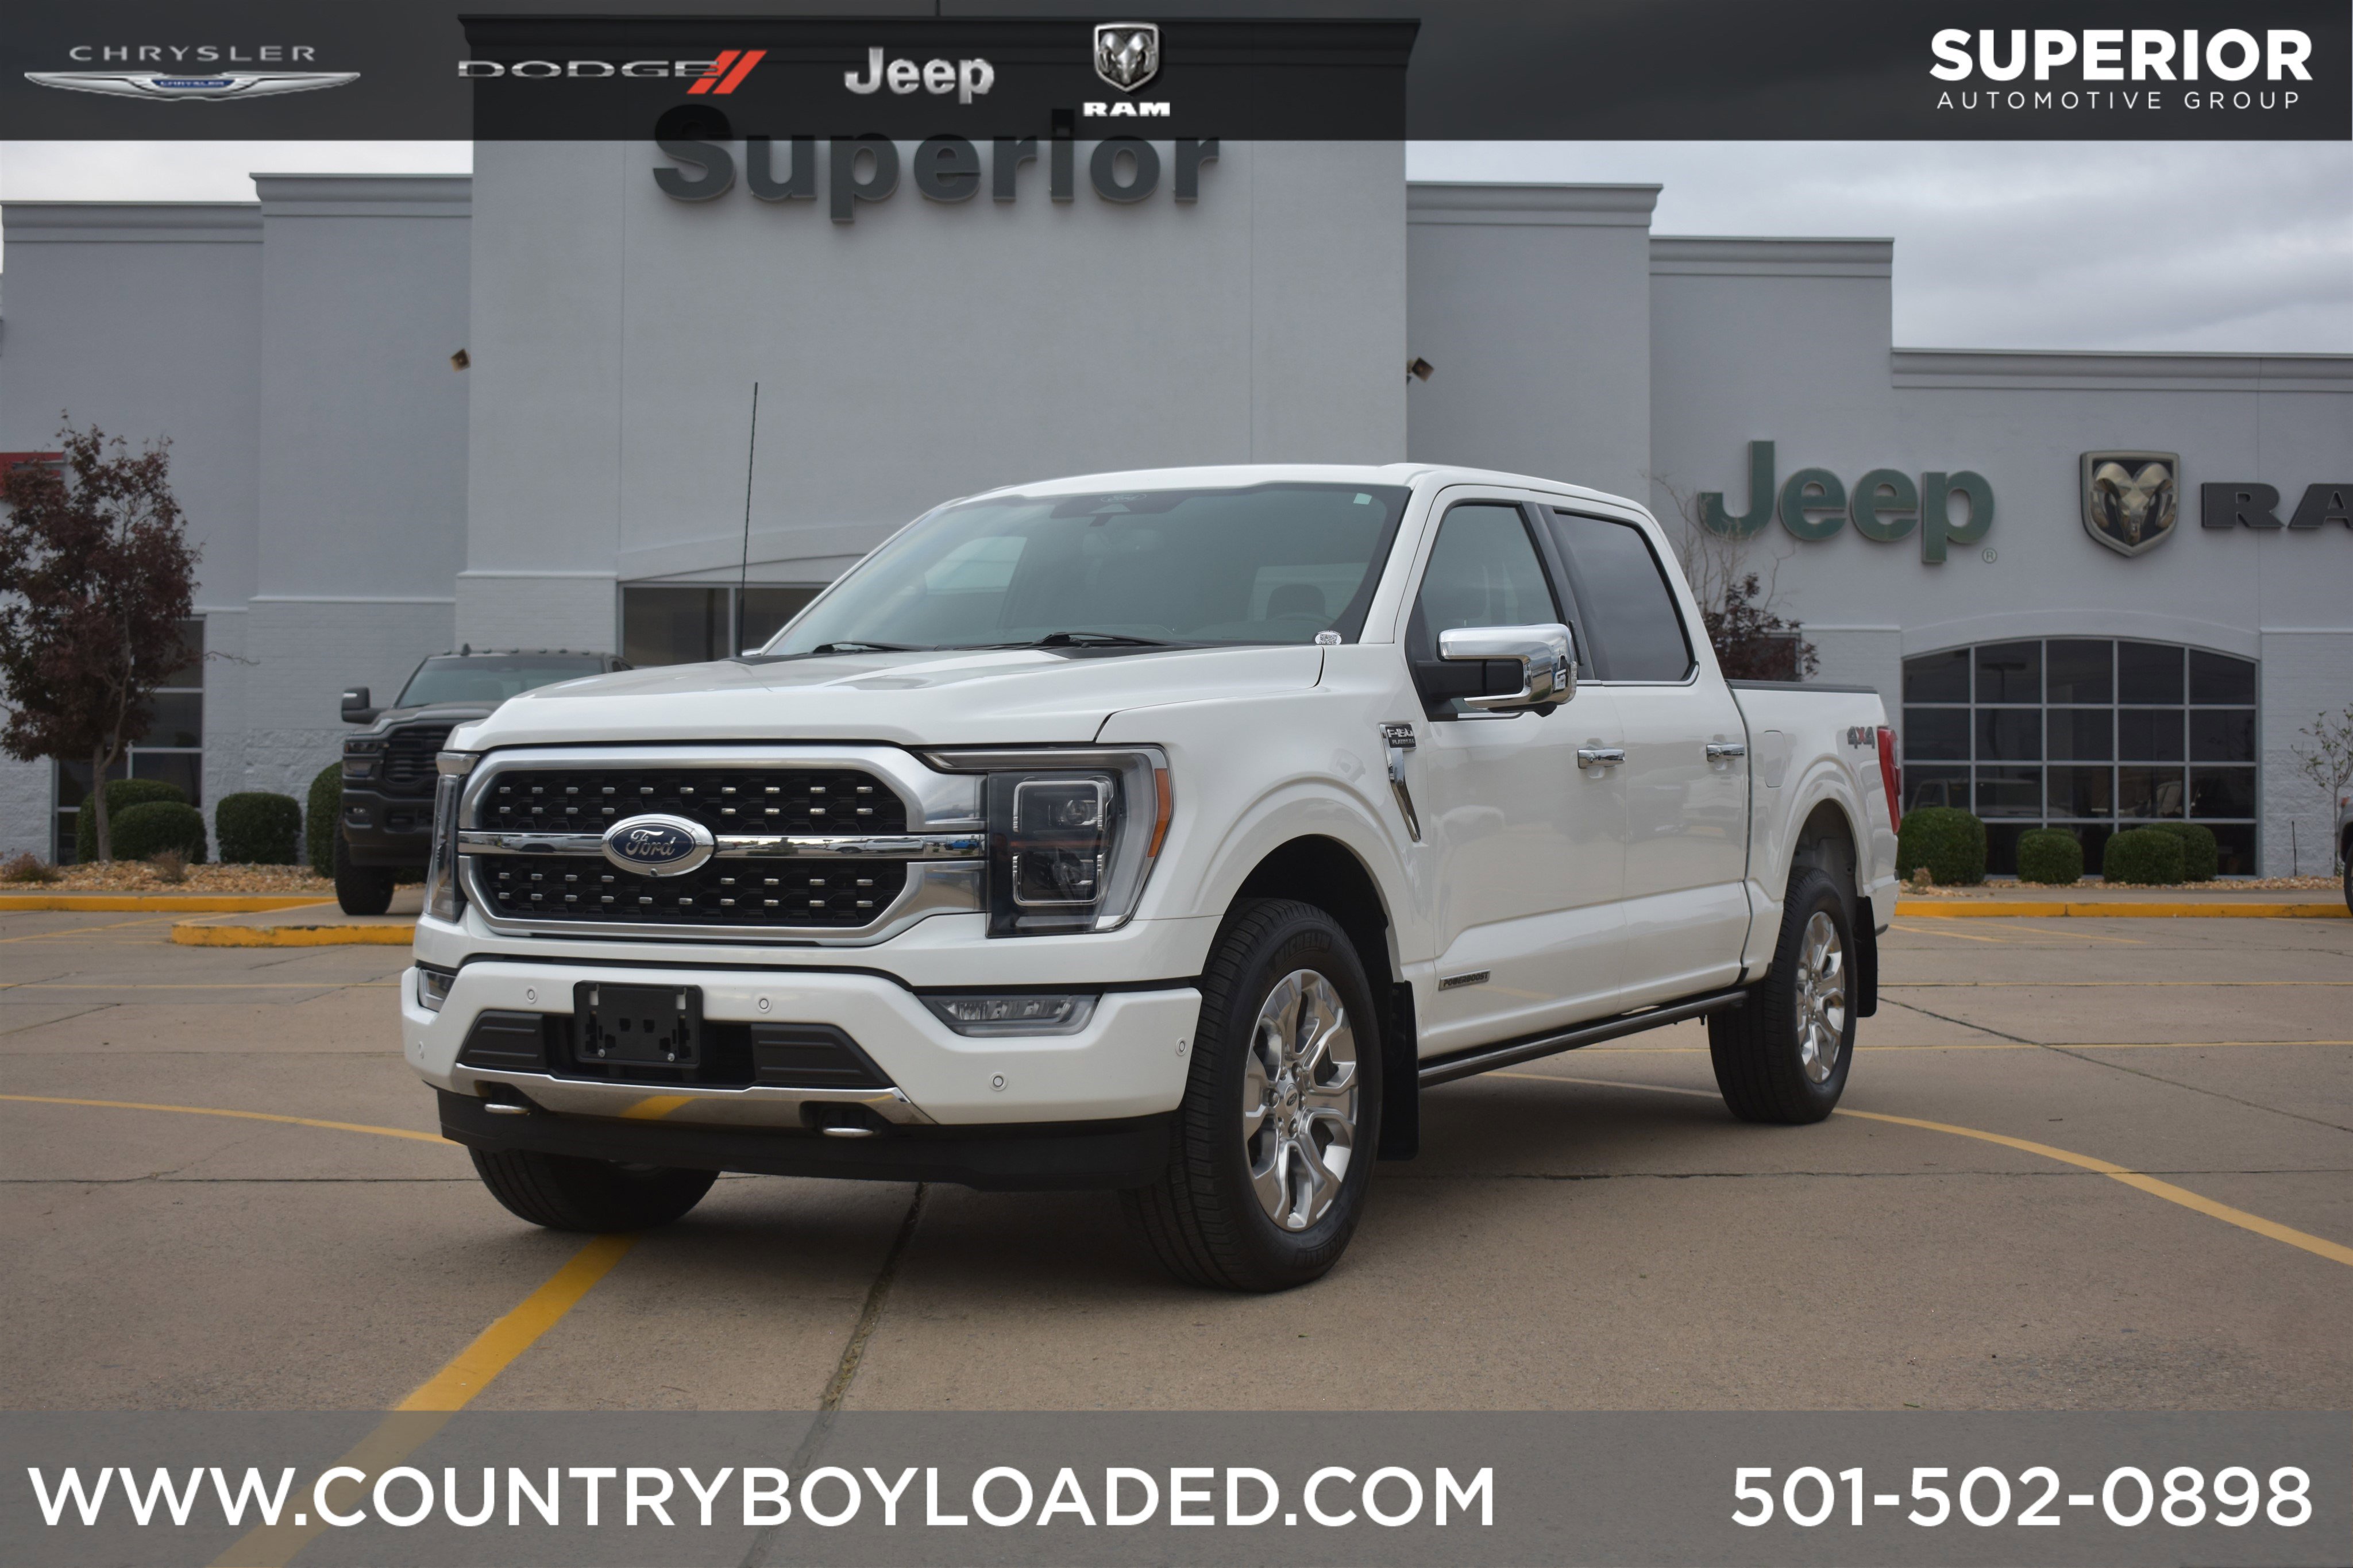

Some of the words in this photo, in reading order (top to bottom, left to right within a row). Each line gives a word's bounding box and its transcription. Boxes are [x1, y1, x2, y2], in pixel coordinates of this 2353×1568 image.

[653, 104, 1220, 224] Superior
[1698, 441, 1995, 563] Jeep
[625, 829, 676, 856] Ford
[1443, 972, 1489, 987] POWERBOOST
